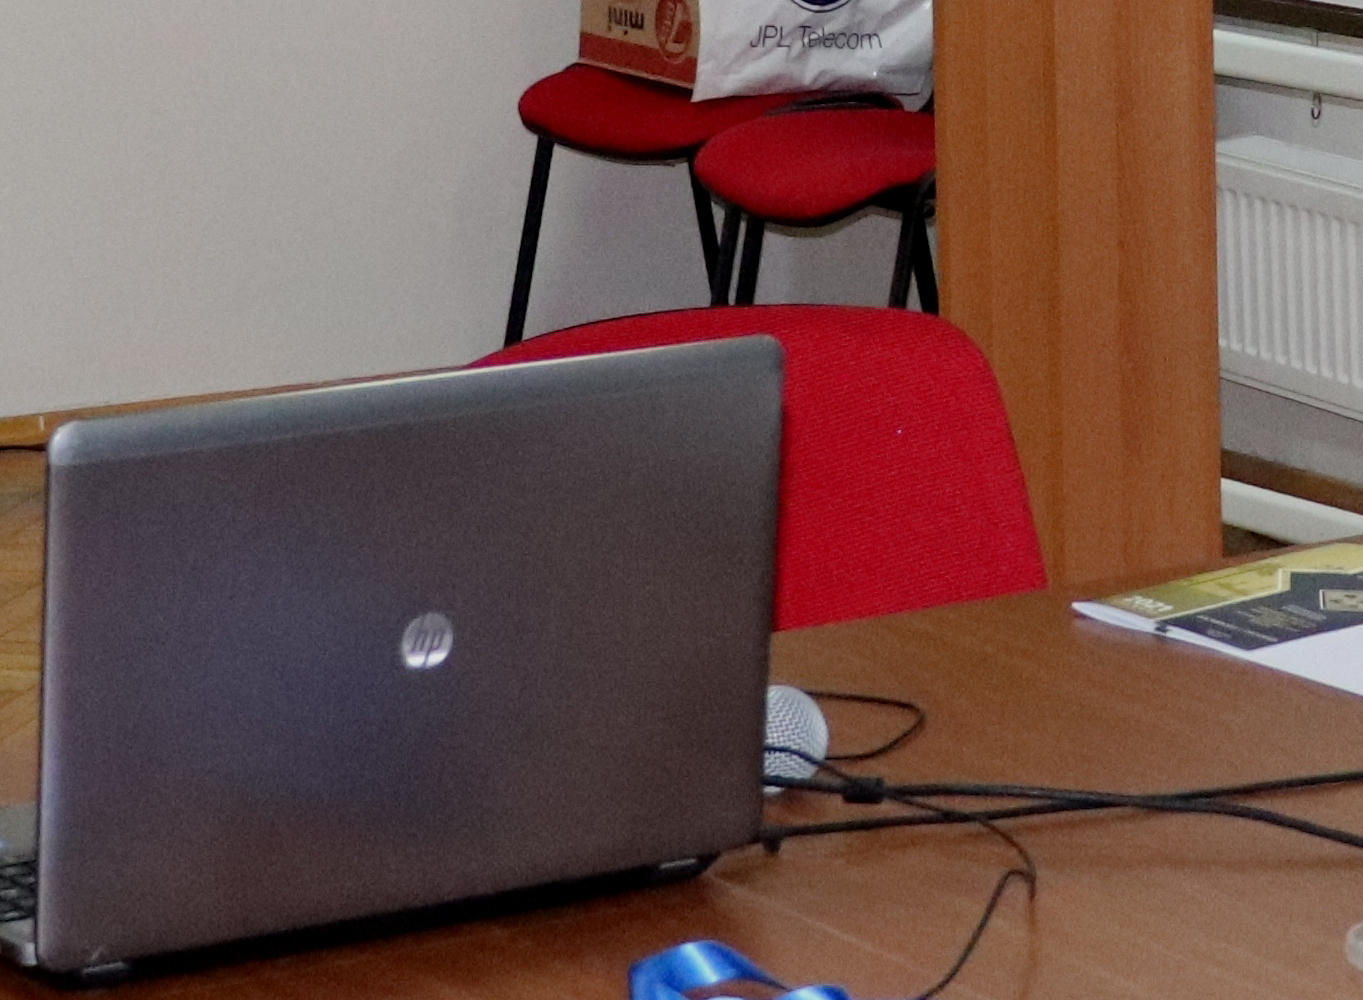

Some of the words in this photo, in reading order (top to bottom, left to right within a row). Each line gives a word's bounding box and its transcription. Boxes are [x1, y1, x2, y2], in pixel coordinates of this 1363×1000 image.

[608, 5, 645, 36] mini
[749, 25, 791, 49] JPL
[798, 25, 883, 50] Telecom
